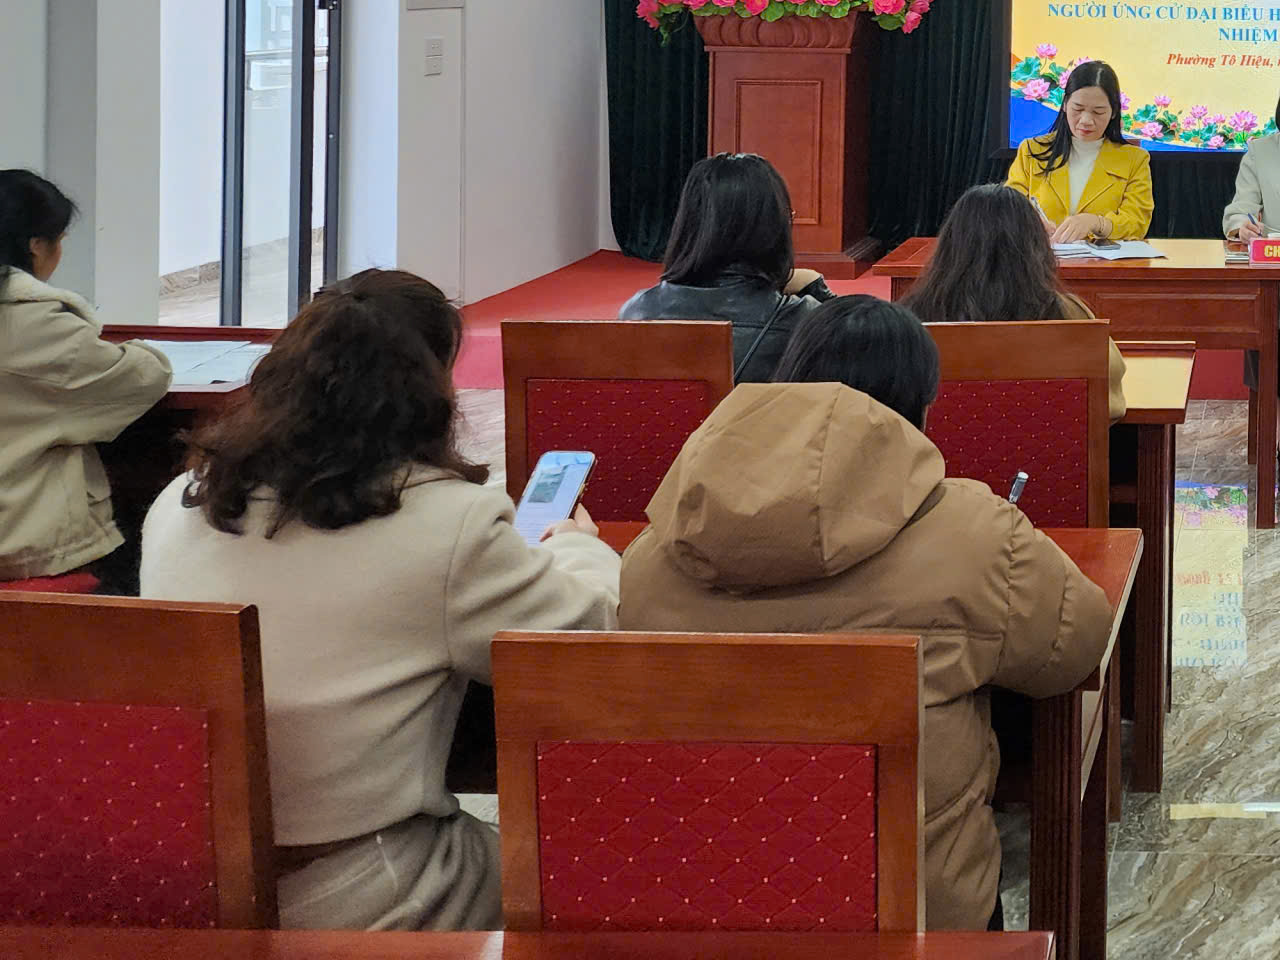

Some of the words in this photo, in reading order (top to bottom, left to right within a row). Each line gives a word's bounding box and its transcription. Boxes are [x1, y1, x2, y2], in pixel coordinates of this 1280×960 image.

[1047, 1, 1107, 18] NGƯỜI
[1112, 1, 1151, 19] ỨNG
[1155, 2, 1183, 20] CỬ
[1186, 6, 1217, 23] ĐẠI
[1222, 3, 1263, 21] BIỂU
[1218, 27, 1277, 45] NHIỆM
[1166, 53, 1216, 68] Phường
[1221, 54, 1236, 66] Tô
[1240, 54, 1274, 68] Hiệu,
